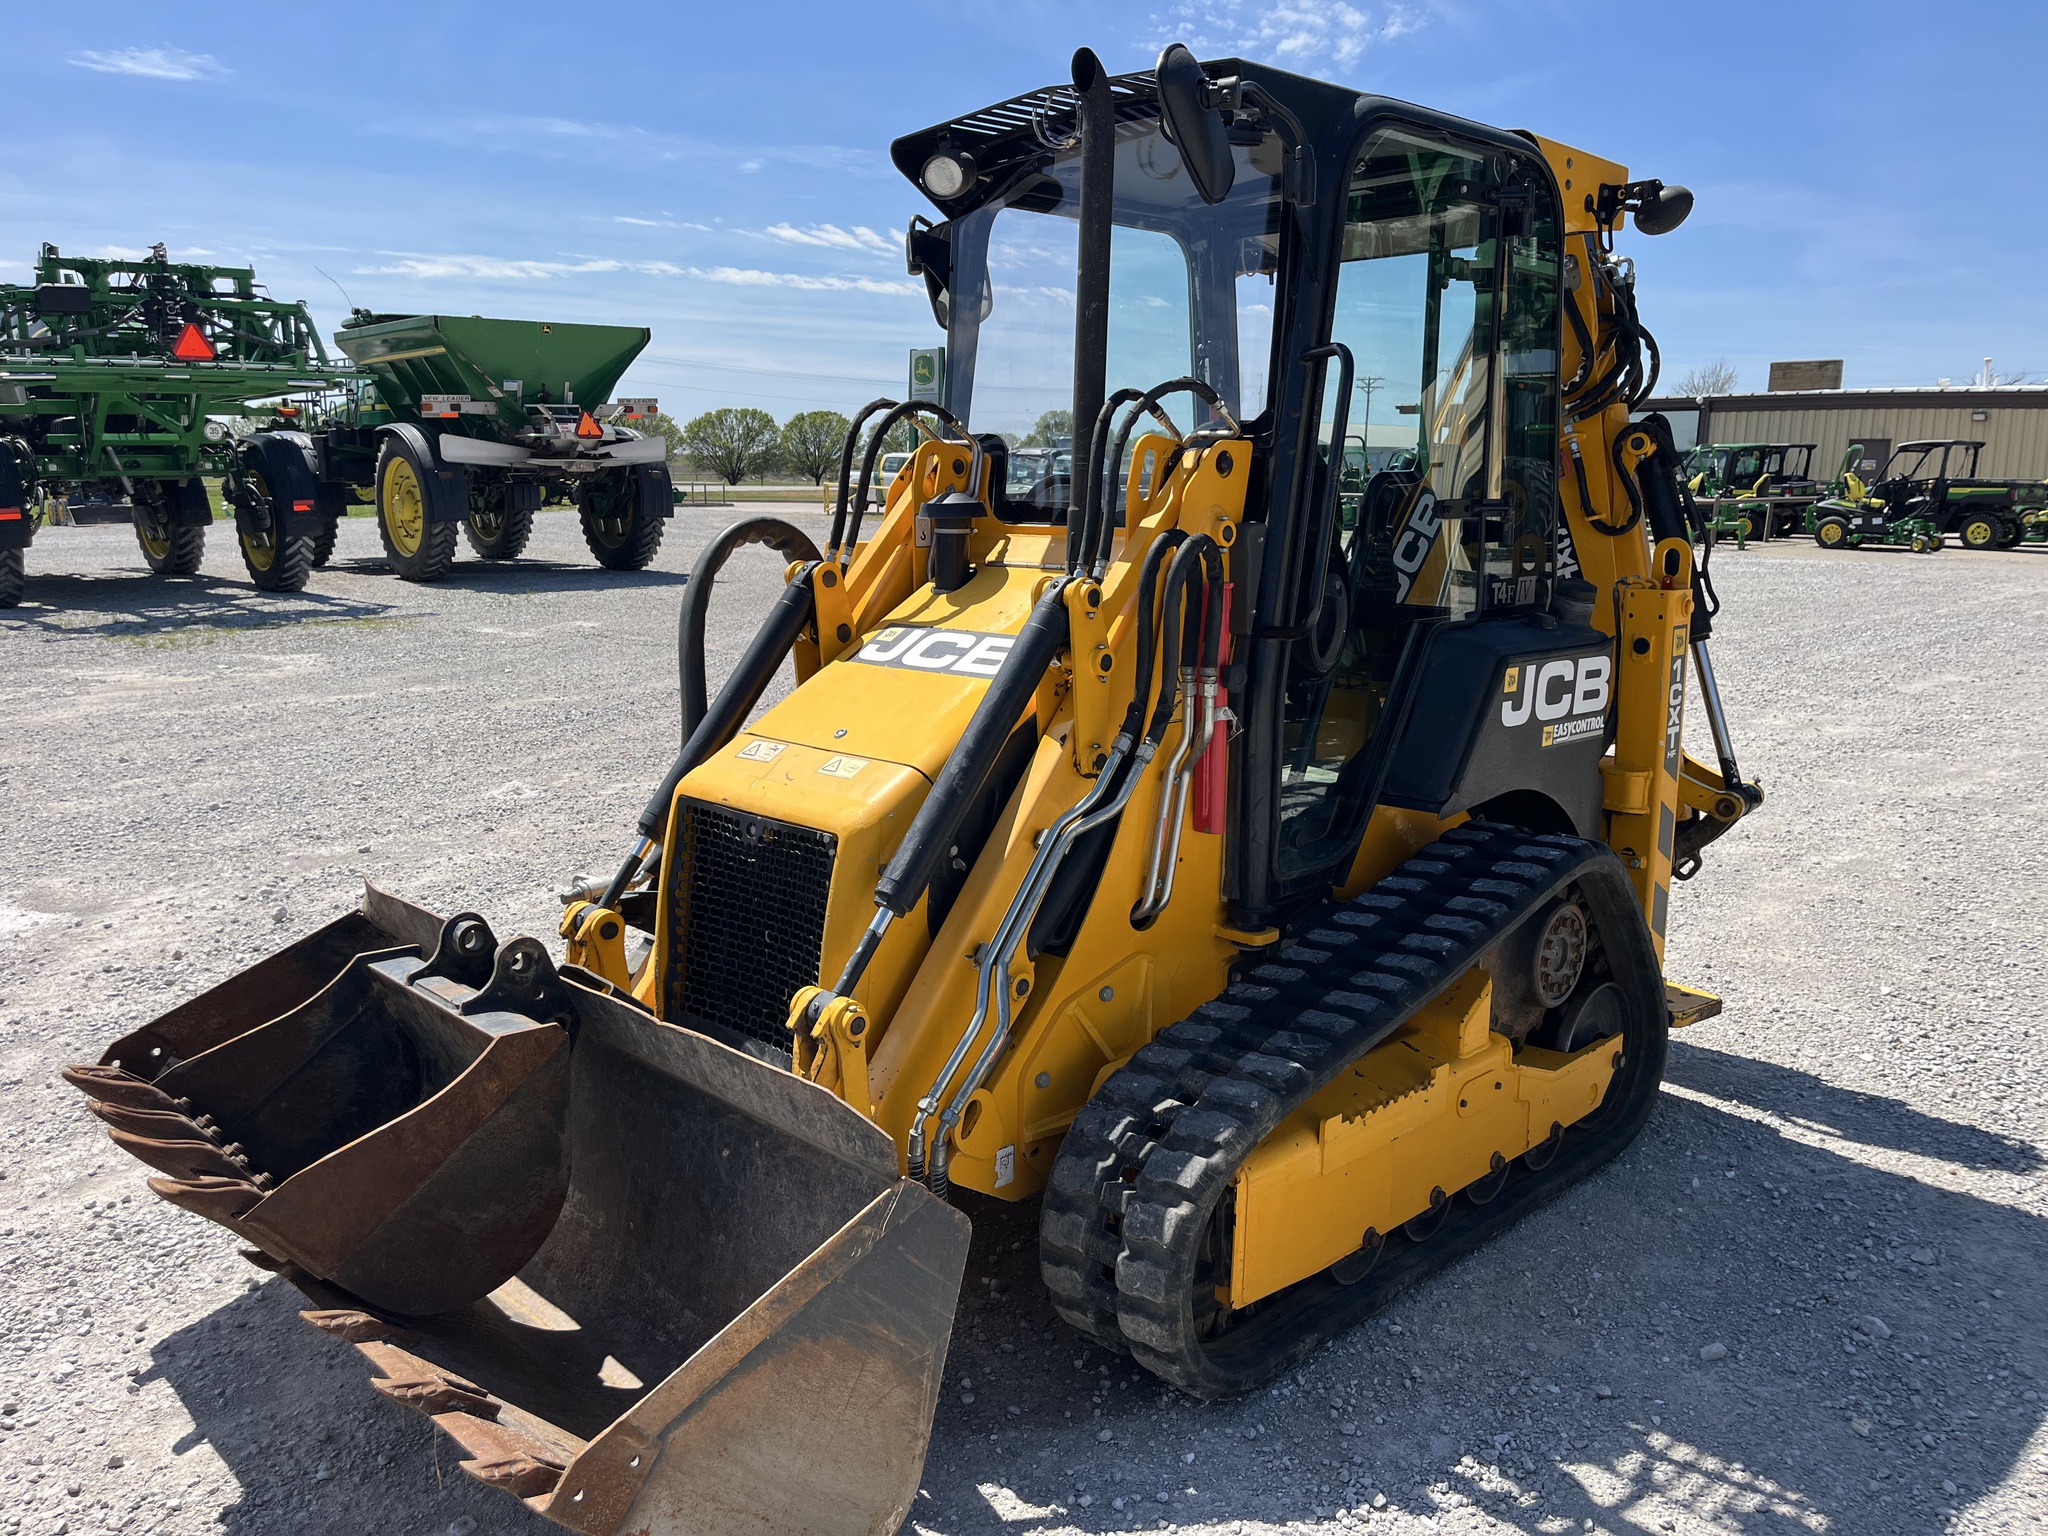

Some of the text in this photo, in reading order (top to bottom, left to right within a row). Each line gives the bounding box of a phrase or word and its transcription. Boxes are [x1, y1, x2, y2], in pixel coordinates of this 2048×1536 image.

[210, 426, 219, 435] 35
[1501, 655, 1611, 727] JCB
[1667, 658, 1683, 749] 1CXT
[1666, 749, 1677, 760] HF
